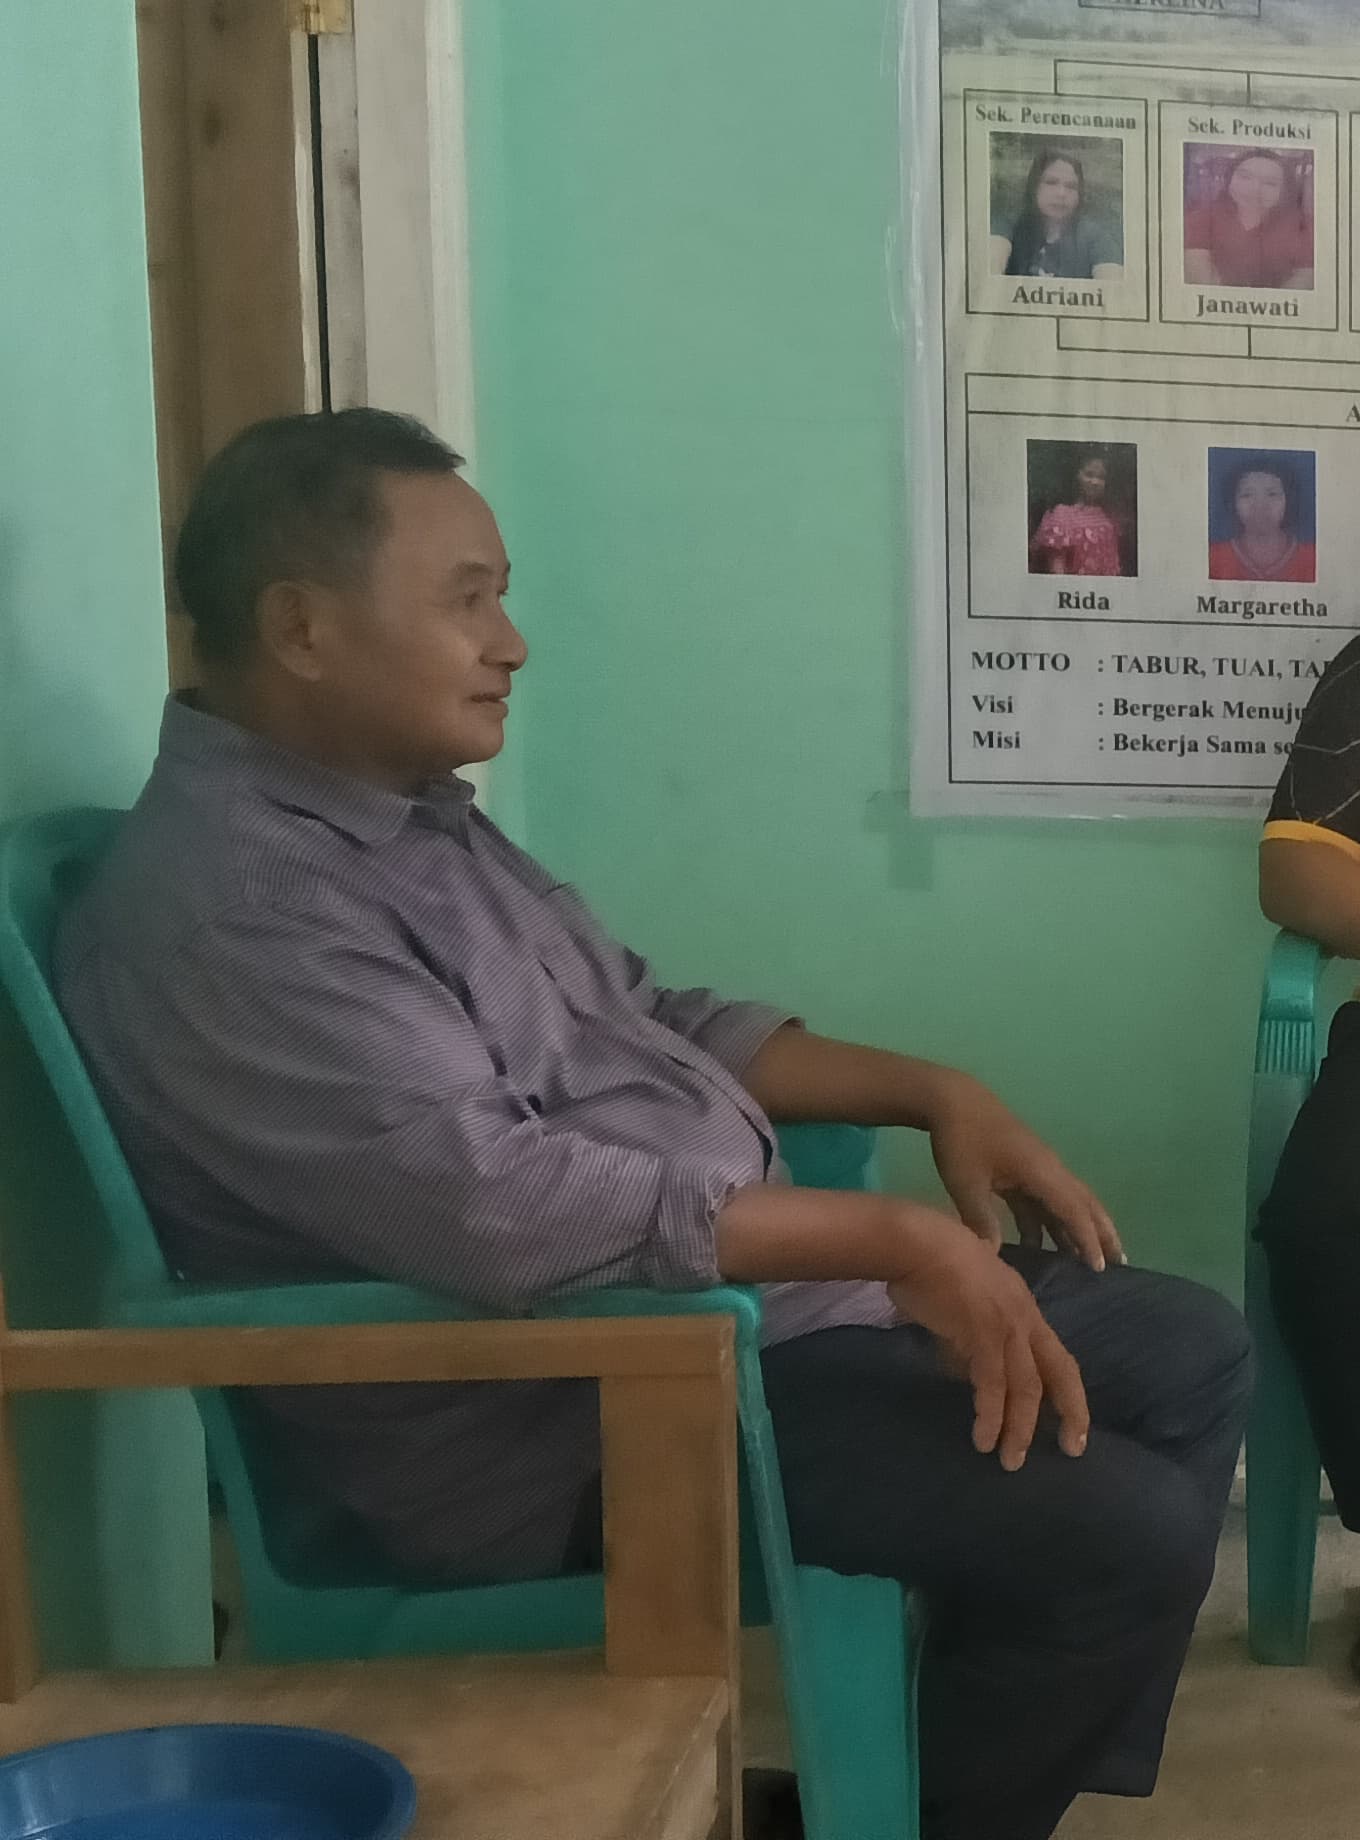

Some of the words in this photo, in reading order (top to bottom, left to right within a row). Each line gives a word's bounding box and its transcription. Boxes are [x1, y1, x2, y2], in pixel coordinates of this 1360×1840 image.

[975, 104, 1014, 123] Sek.
[1020, 106, 1137, 131] Perencanaan
[1188, 116, 1225, 135] Sek.
[1232, 119, 1312, 140] Produksi
[1012, 285, 1104, 308] Adriani
[1196, 294, 1300, 318] Janawati
[1057, 591, 1110, 612] Rida
[1197, 596, 1329, 619] Margaretha
[970, 651, 1071, 673] MOTTO
[1112, 654, 1207, 678] TABUR,
[1212, 657, 1283, 680] TUAI,
[971, 694, 1014, 714] Visi
[1112, 697, 1216, 723] Bergerak
[971, 730, 1021, 750] Misi
[1113, 733, 1200, 757] Bekerja
[1206, 735, 1267, 755] Sama
